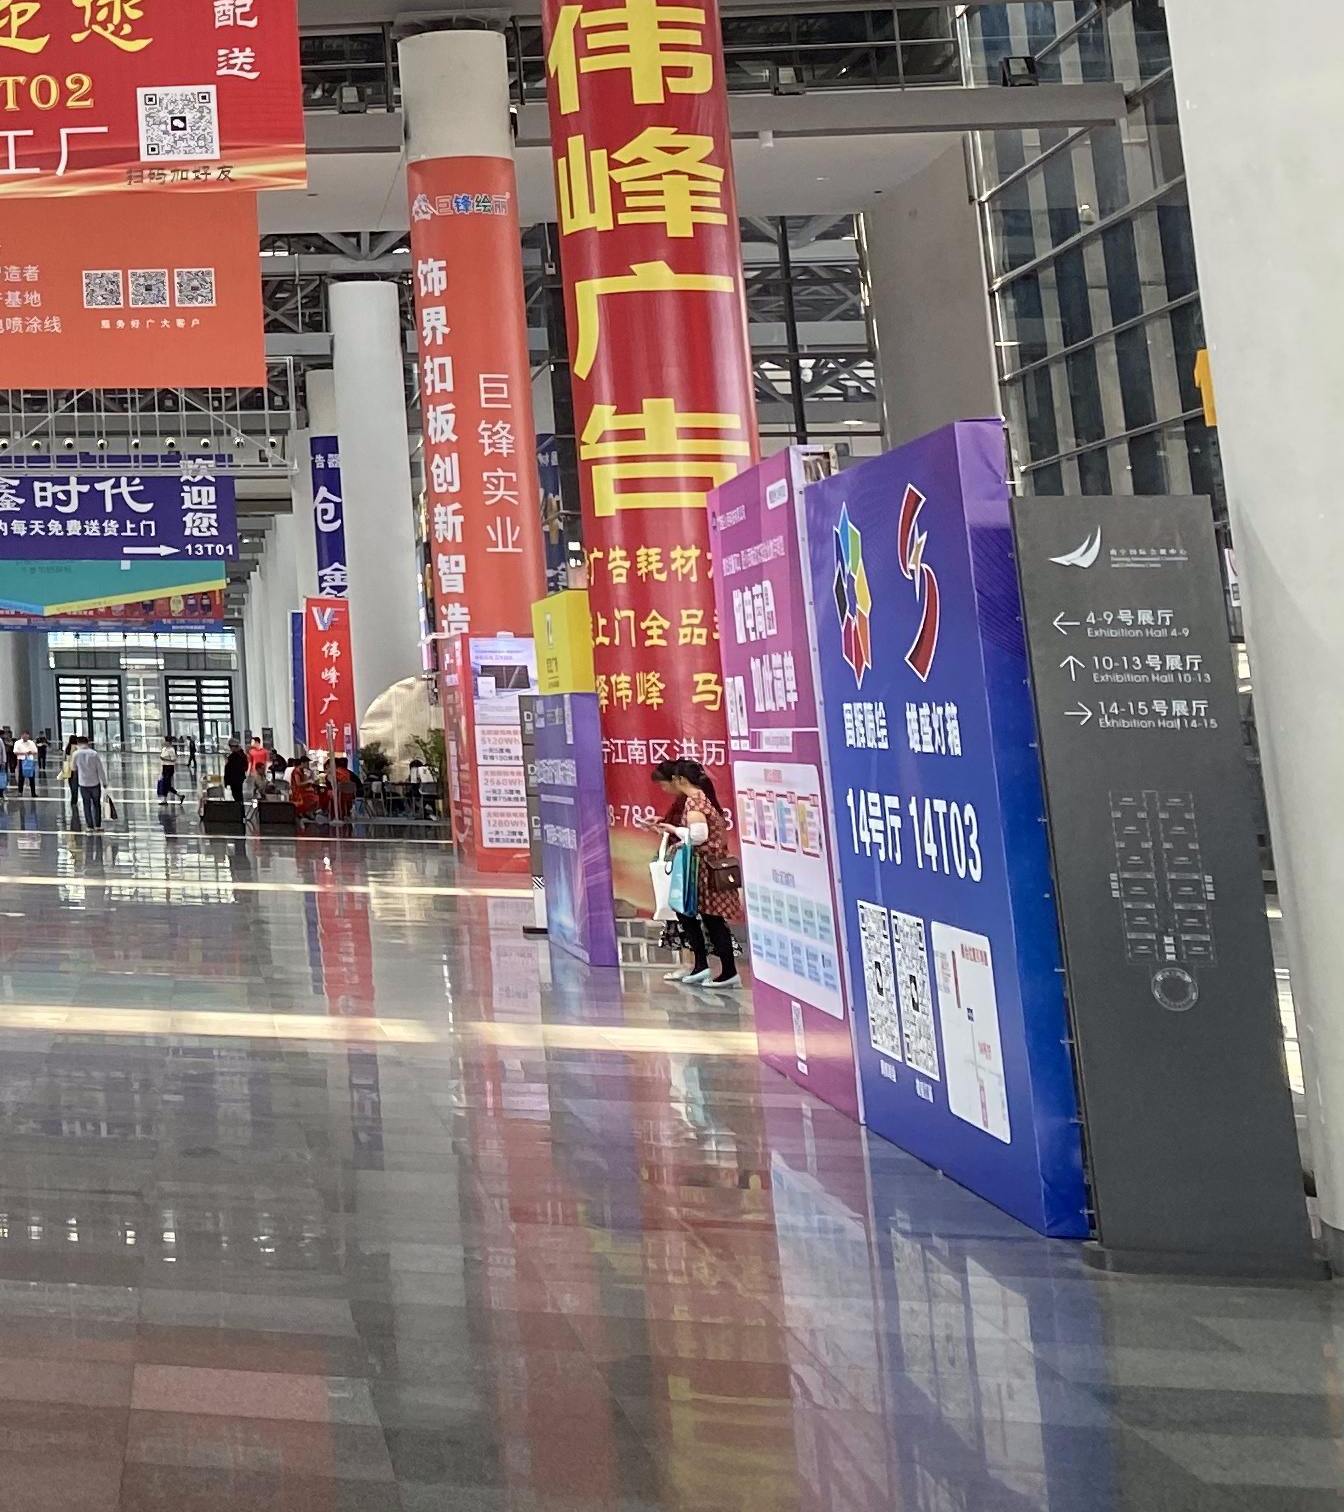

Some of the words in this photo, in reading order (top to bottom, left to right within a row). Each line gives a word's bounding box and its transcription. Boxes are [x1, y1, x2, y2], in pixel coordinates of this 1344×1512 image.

[126, 164, 237, 187] 扫码加好友
[478, 372, 524, 555] 巨锋实业
[179, 458, 220, 538] 欢迎您
[184, 544, 234, 557] 13T01
[1085, 609, 1174, 626] 4-9号展厅
[1087, 627, 1143, 638] Exhibition
[1170, 628, 1190, 637] 4-9
[1092, 654, 1202, 671] 10-13号展厅
[1093, 673, 1149, 683] Exhibition
[1177, 673, 1212, 683] 10-13
[1098, 700, 1209, 717] 14-15号展厅
[1098, 718, 1156, 729] Exhibition
[1183, 718, 1218, 729] 14-15
[847, 788, 903, 866] 14号厅
[908, 796, 983, 883] 14T03
